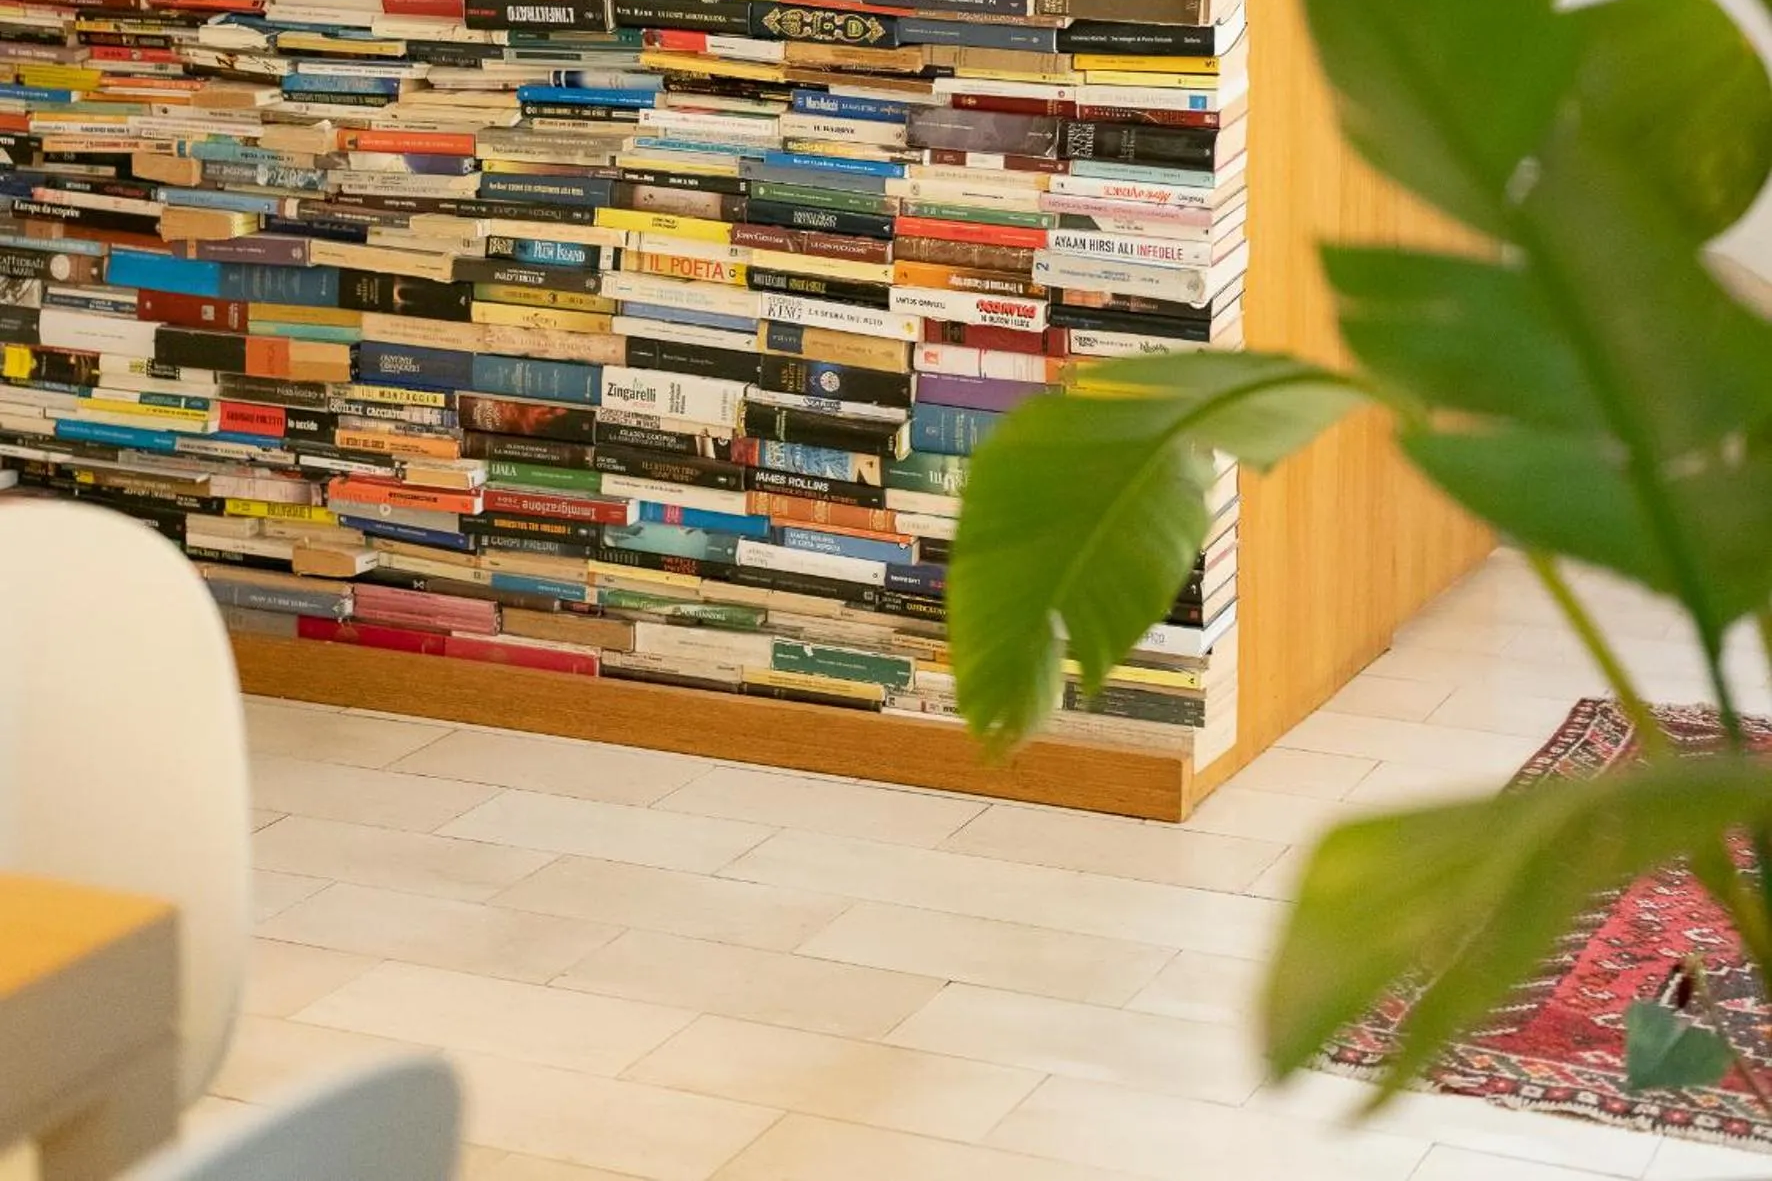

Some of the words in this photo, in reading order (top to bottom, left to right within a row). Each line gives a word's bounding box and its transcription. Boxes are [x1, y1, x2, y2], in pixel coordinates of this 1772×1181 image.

[14, 199, 40, 215] Europa
[42, 203, 50, 213] da
[52, 205, 80, 219] scoprire
[556, 243, 586, 261] ISLAND
[1054, 235, 1086, 250] AYAAN
[1090, 238, 1114, 253] HIRSI
[1118, 241, 1134, 255] ALI
[1136, 243, 1183, 260] INFEDELE
[650, 256, 662, 271] IL
[670, 257, 724, 279] POETA
[1036, 262, 1050, 271] 2
[768, 304, 802, 319] KING
[606, 382, 656, 402] Zingarelli
[296, 420, 318, 431] uccido
[756, 471, 786, 484] JAMES
[788, 475, 830, 492] ROLLINS
[522, 500, 596, 519] Immigrazione
